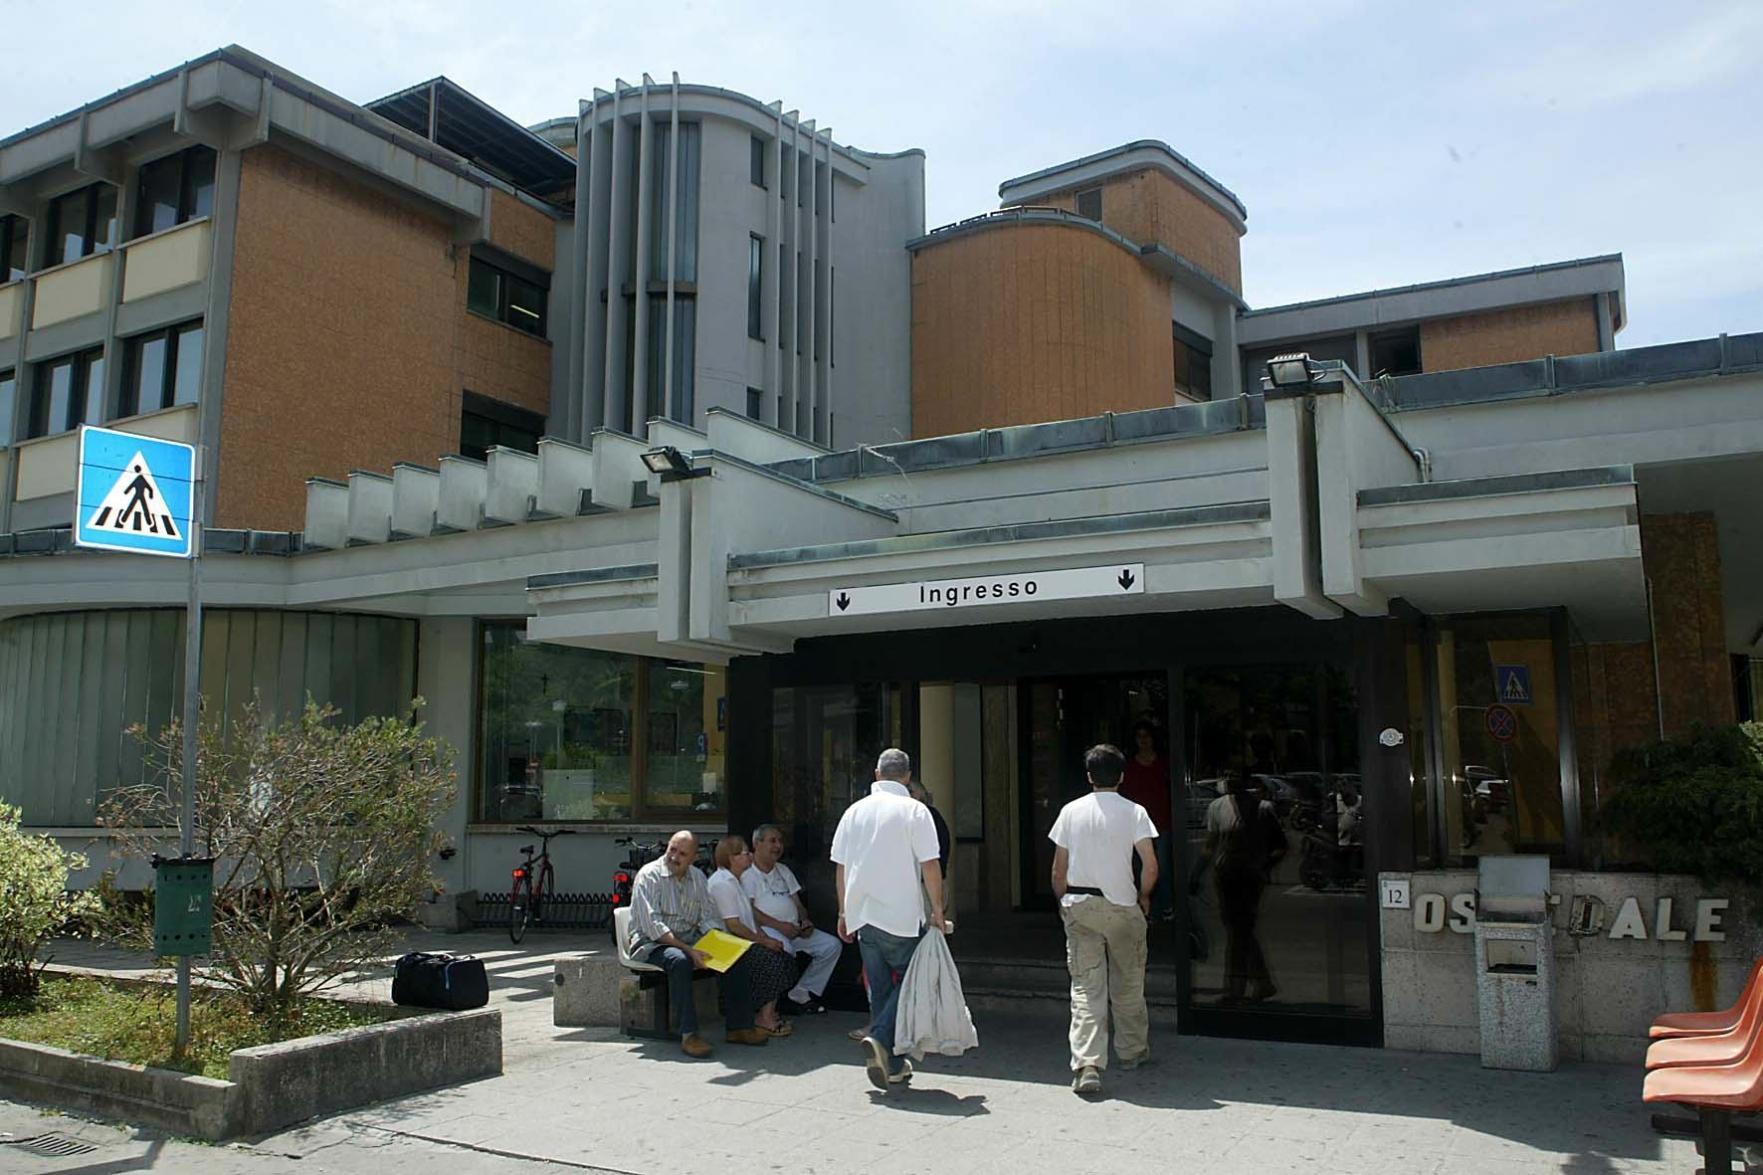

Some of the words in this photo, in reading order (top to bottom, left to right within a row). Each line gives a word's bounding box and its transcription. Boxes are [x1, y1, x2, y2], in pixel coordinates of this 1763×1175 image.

[920, 580, 1038, 606] Ingresso
[1389, 889, 1403, 904] 12
[1414, 893, 1729, 941] OSDALE
